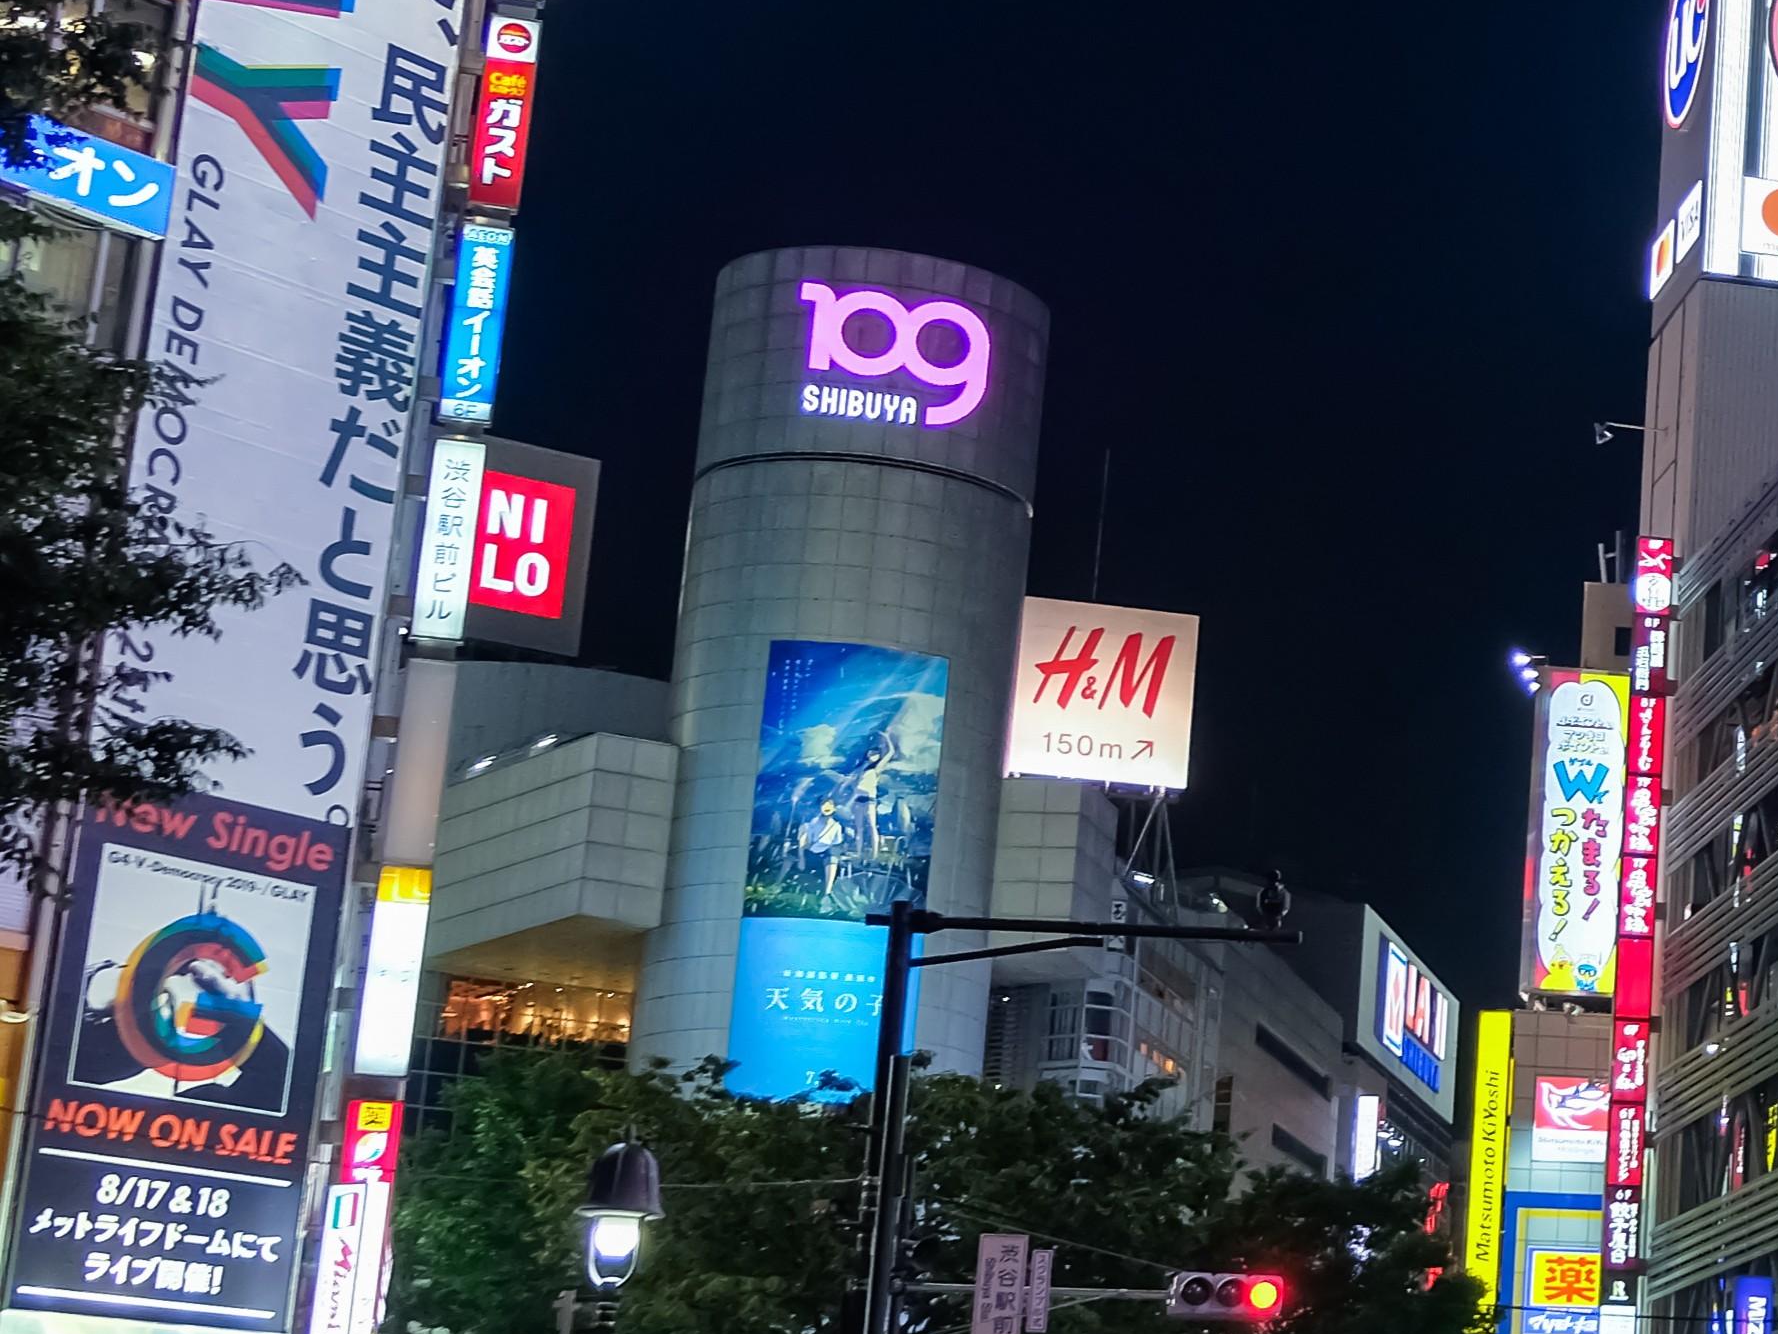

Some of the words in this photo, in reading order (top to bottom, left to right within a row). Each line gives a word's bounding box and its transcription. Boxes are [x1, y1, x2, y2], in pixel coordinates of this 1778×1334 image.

[482, 98, 523, 185] ガスト
[177, 151, 225, 290] GLAY
[800, 281, 991, 425] 109
[802, 383, 918, 425] SHIBUYA
[425, 457, 470, 622] 渋谷駅前ビル
[1033, 625, 1176, 719] H&M
[207, 810, 334, 872] Single
[43, 1097, 140, 1139] NOW
[148, 1111, 210, 1150] ON
[216, 1123, 298, 1165] SALE
[1481, 1070, 1500, 1145] KiYoshi
[1473, 1146, 1500, 1262] Matsumoto
[1544, 1256, 1596, 1303] 薬
